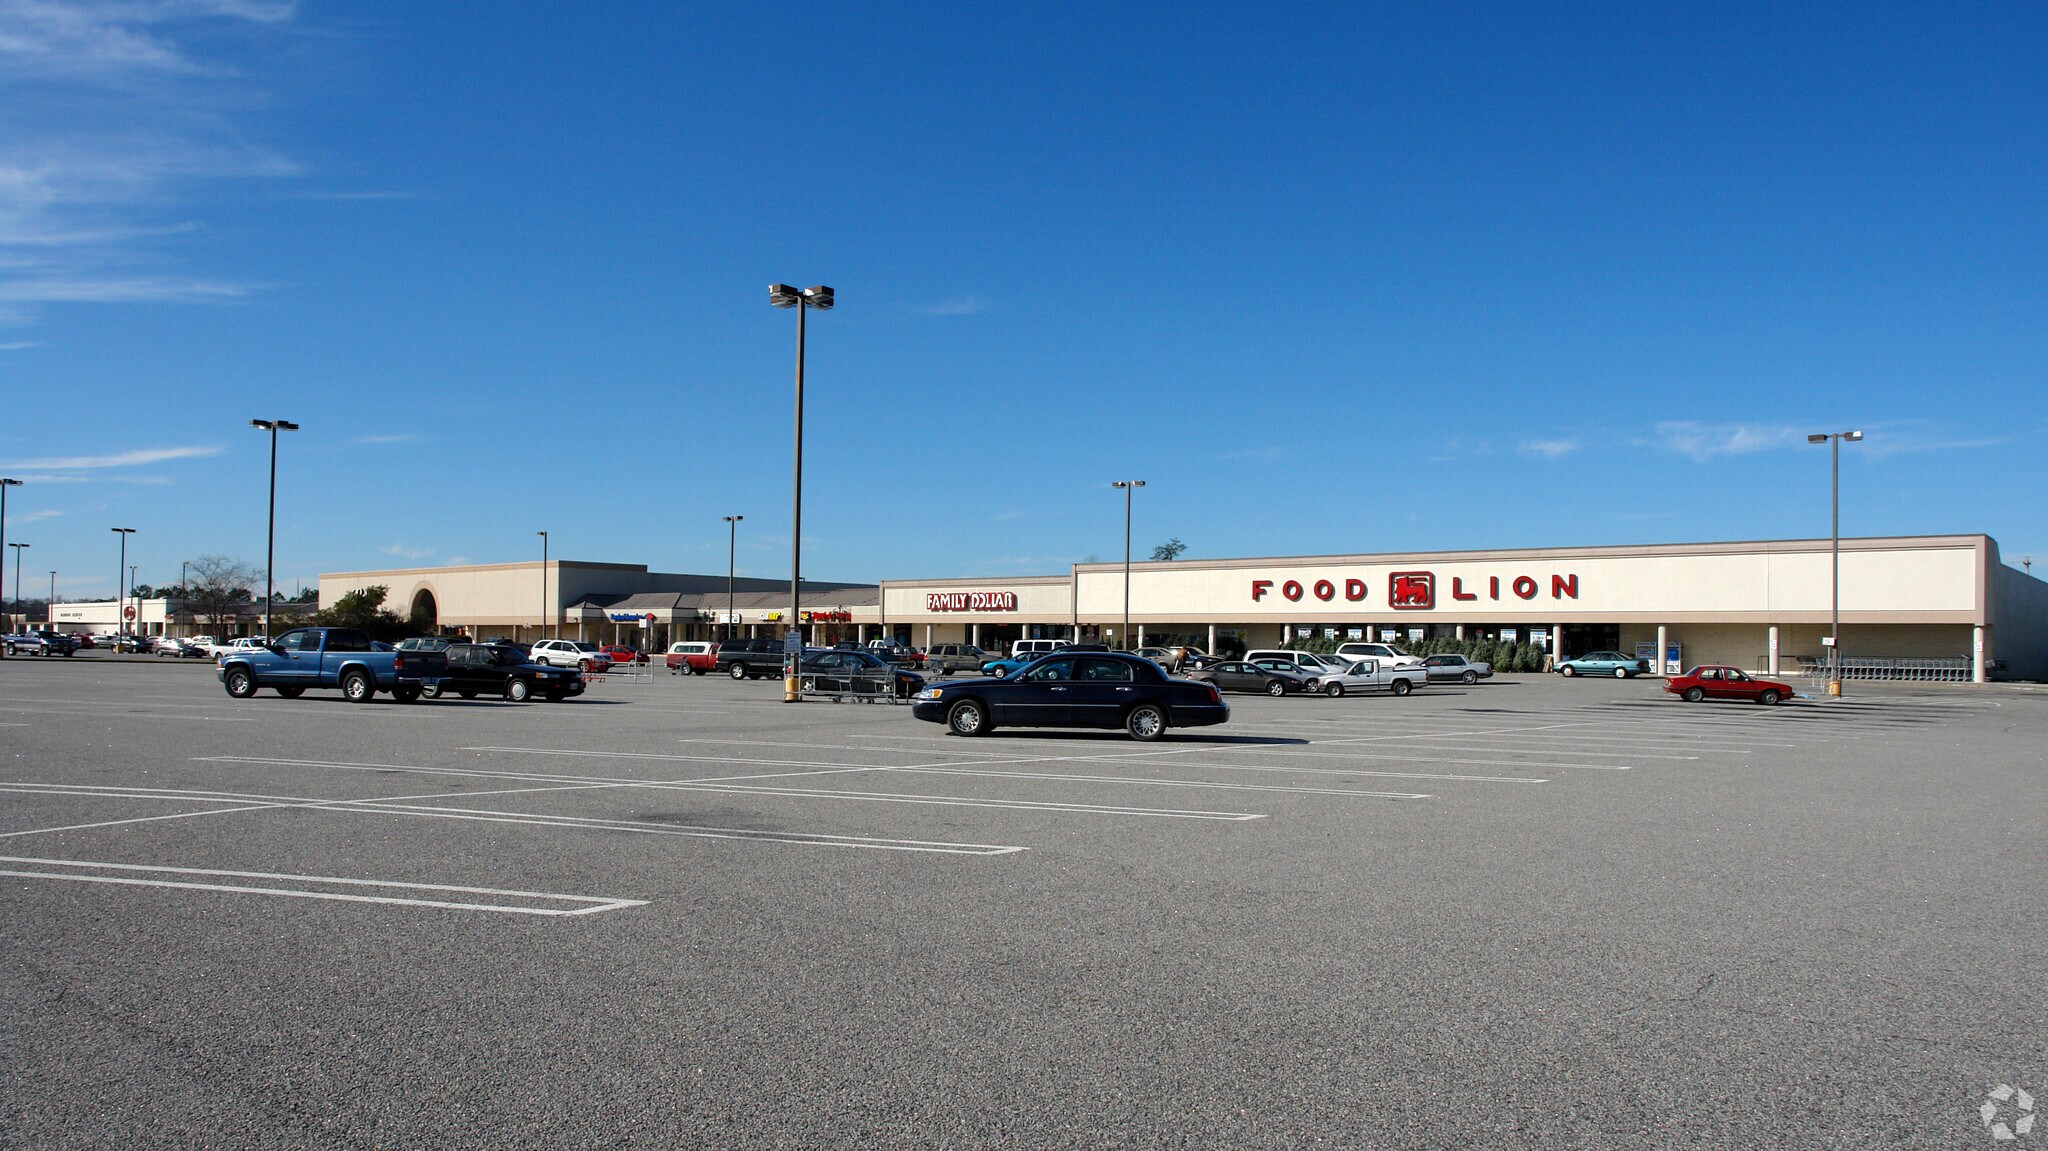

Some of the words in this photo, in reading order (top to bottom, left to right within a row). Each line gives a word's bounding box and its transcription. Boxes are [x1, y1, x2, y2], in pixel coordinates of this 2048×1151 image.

[1252, 579, 1367, 601] FOOD
[1453, 574, 1578, 600] LION
[927, 593, 969, 610] FAMILY
[971, 592, 1015, 610] DOLLAR
